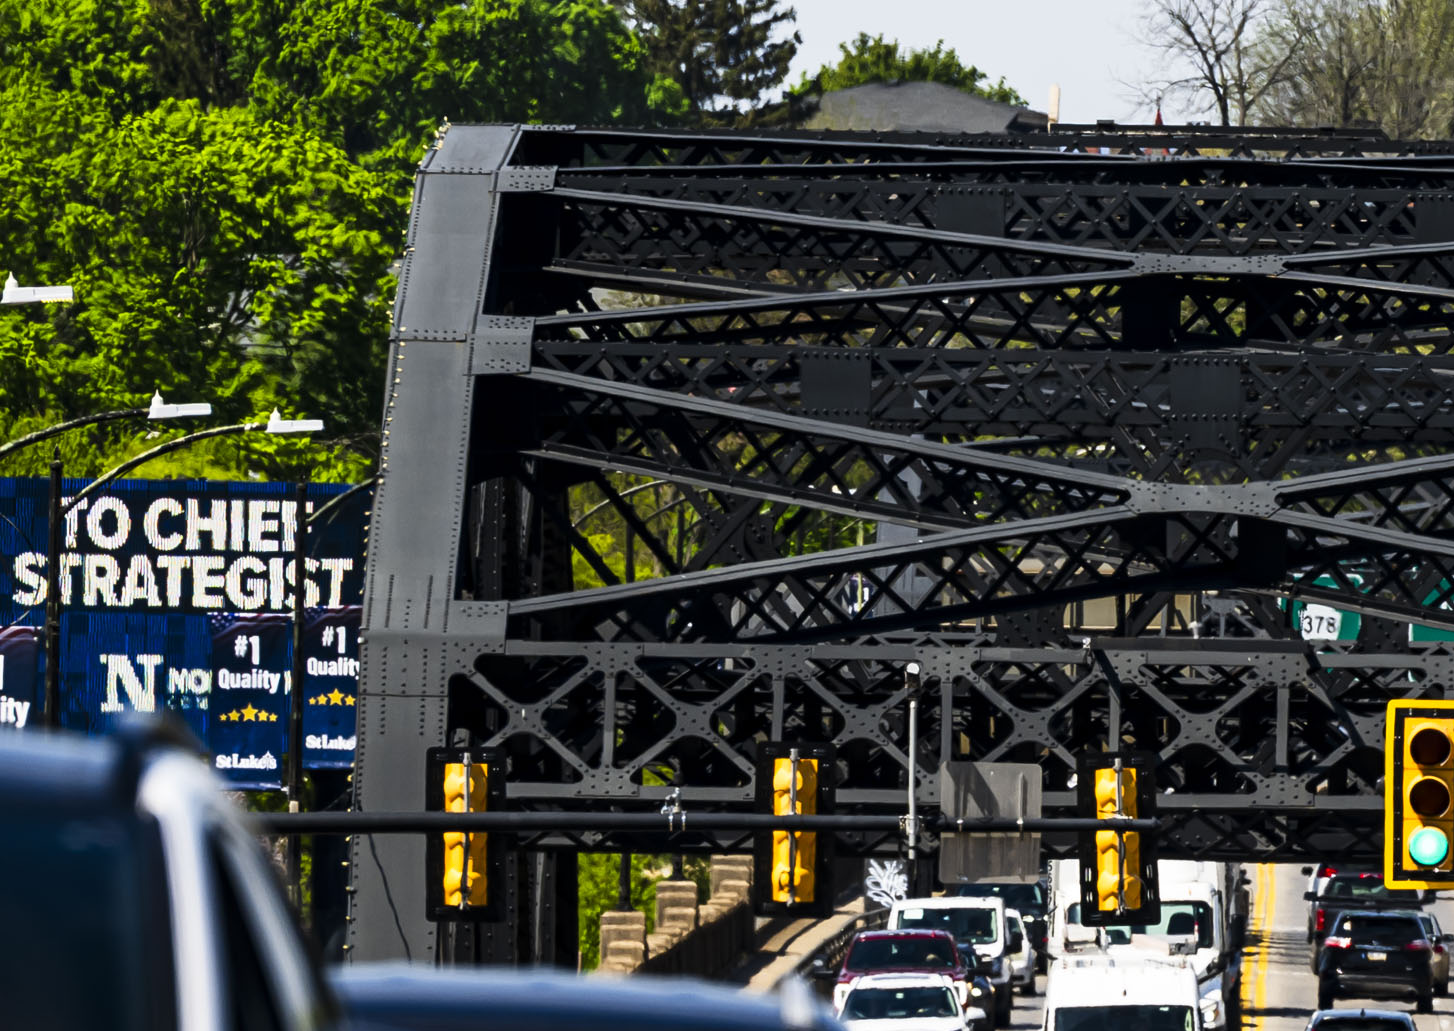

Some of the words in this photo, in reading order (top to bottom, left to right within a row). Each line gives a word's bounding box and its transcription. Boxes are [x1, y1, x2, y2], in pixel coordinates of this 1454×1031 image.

[61, 496, 131, 550] TO
[144, 497, 313, 552] CHIEF
[12, 552, 353, 609] STRATEGIST
[1303, 615, 1337, 634] 378
[234, 635, 261, 665] #1
[321, 625, 347, 654] #1
[218, 668, 281, 694] Quality
[306, 656, 360, 680] Quality
